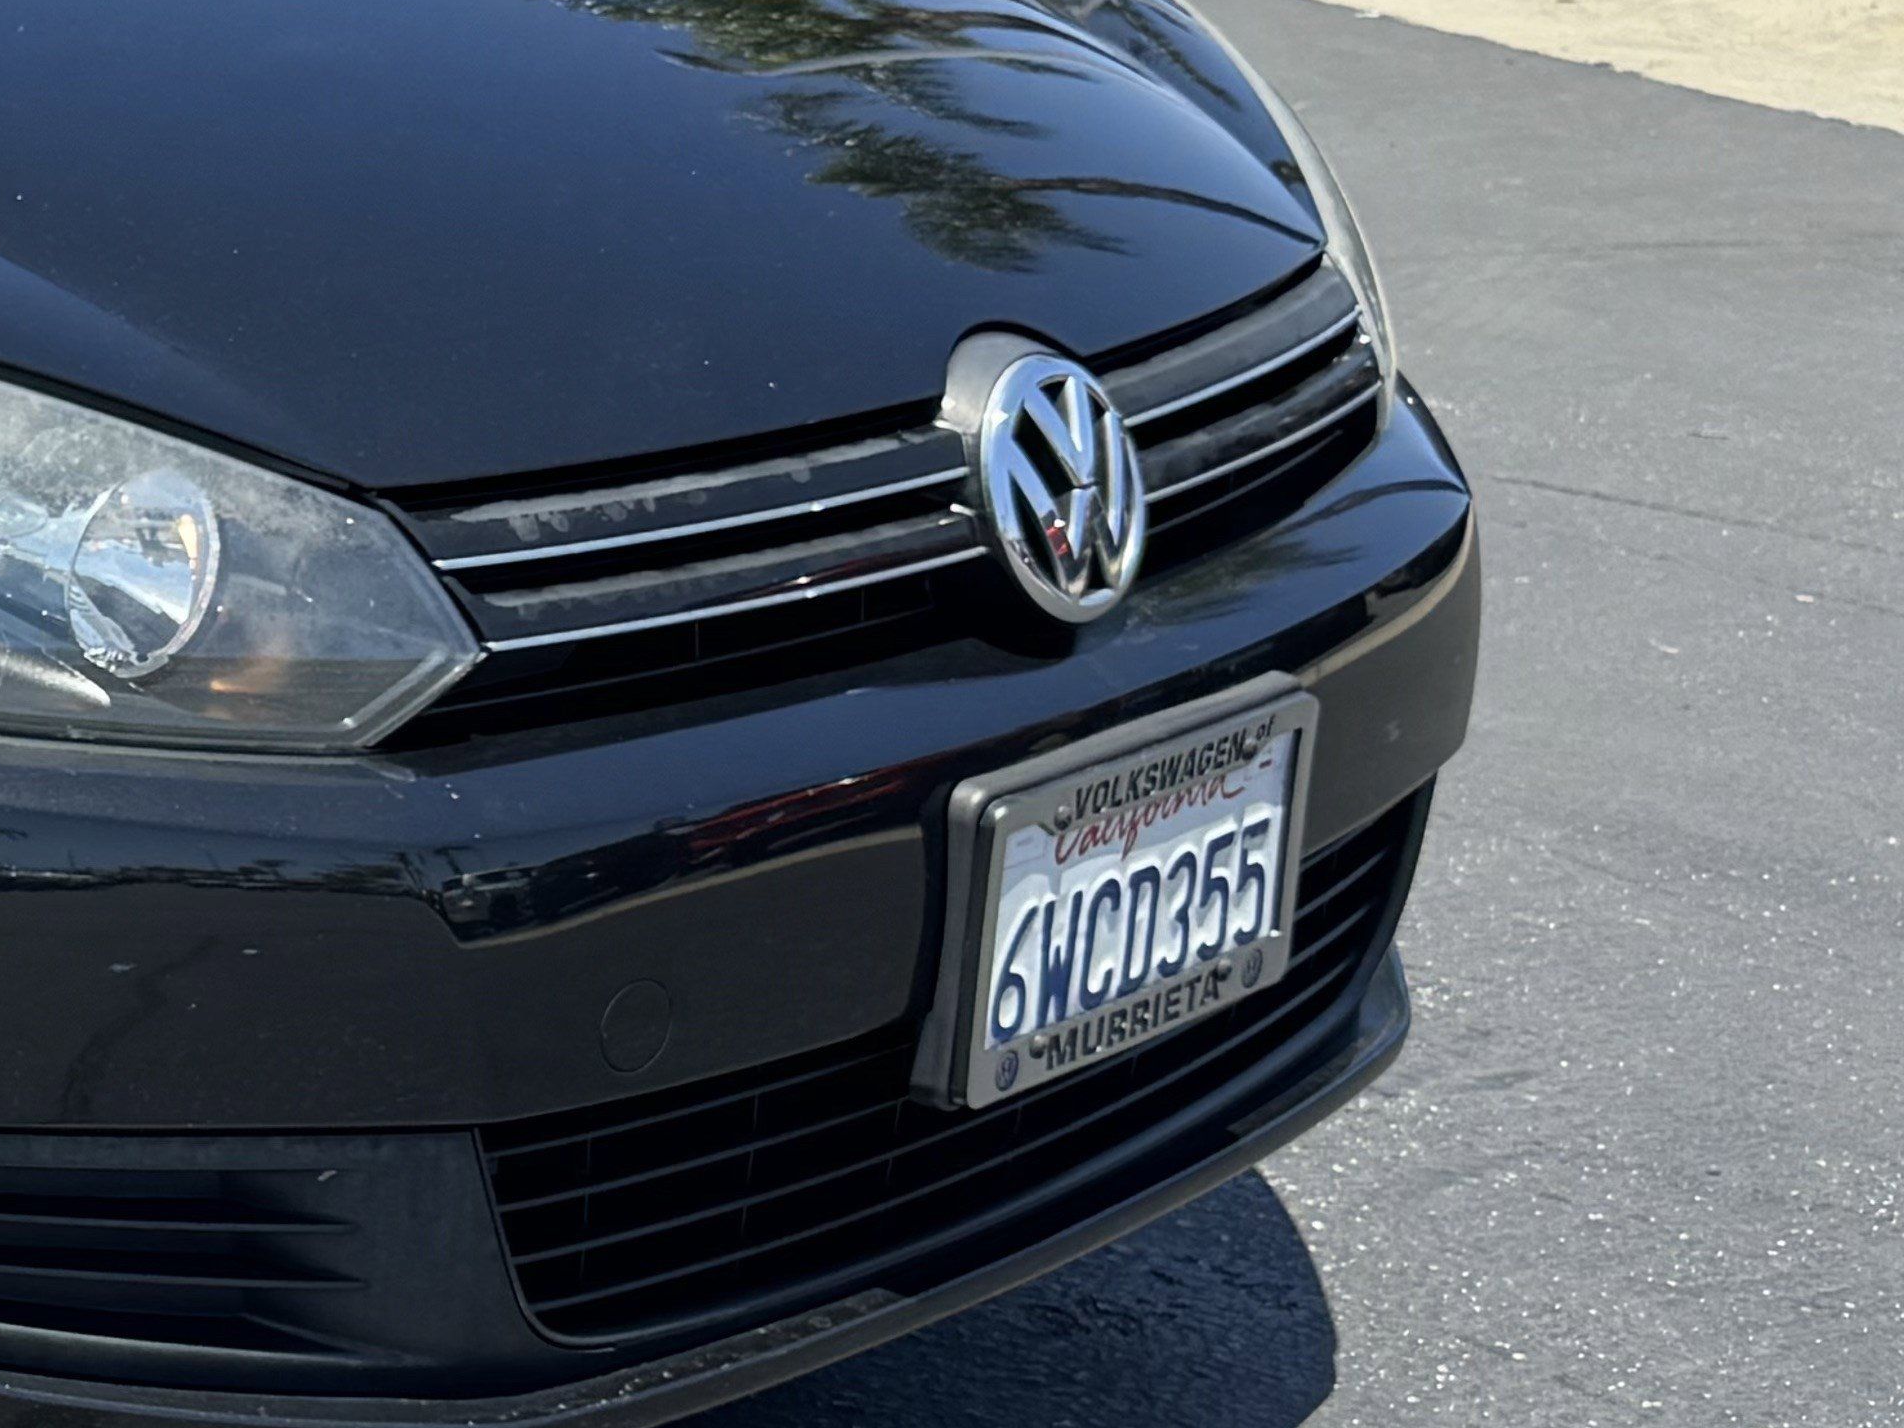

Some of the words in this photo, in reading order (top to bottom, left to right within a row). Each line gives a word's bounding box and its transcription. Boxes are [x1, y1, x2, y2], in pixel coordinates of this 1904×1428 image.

[1074, 730, 1247, 820] VOLKSWAGEN
[1255, 714, 1276, 742] of
[992, 815, 1273, 1042] 6WCD355
[1044, 973, 1221, 1072] MURRIETA
